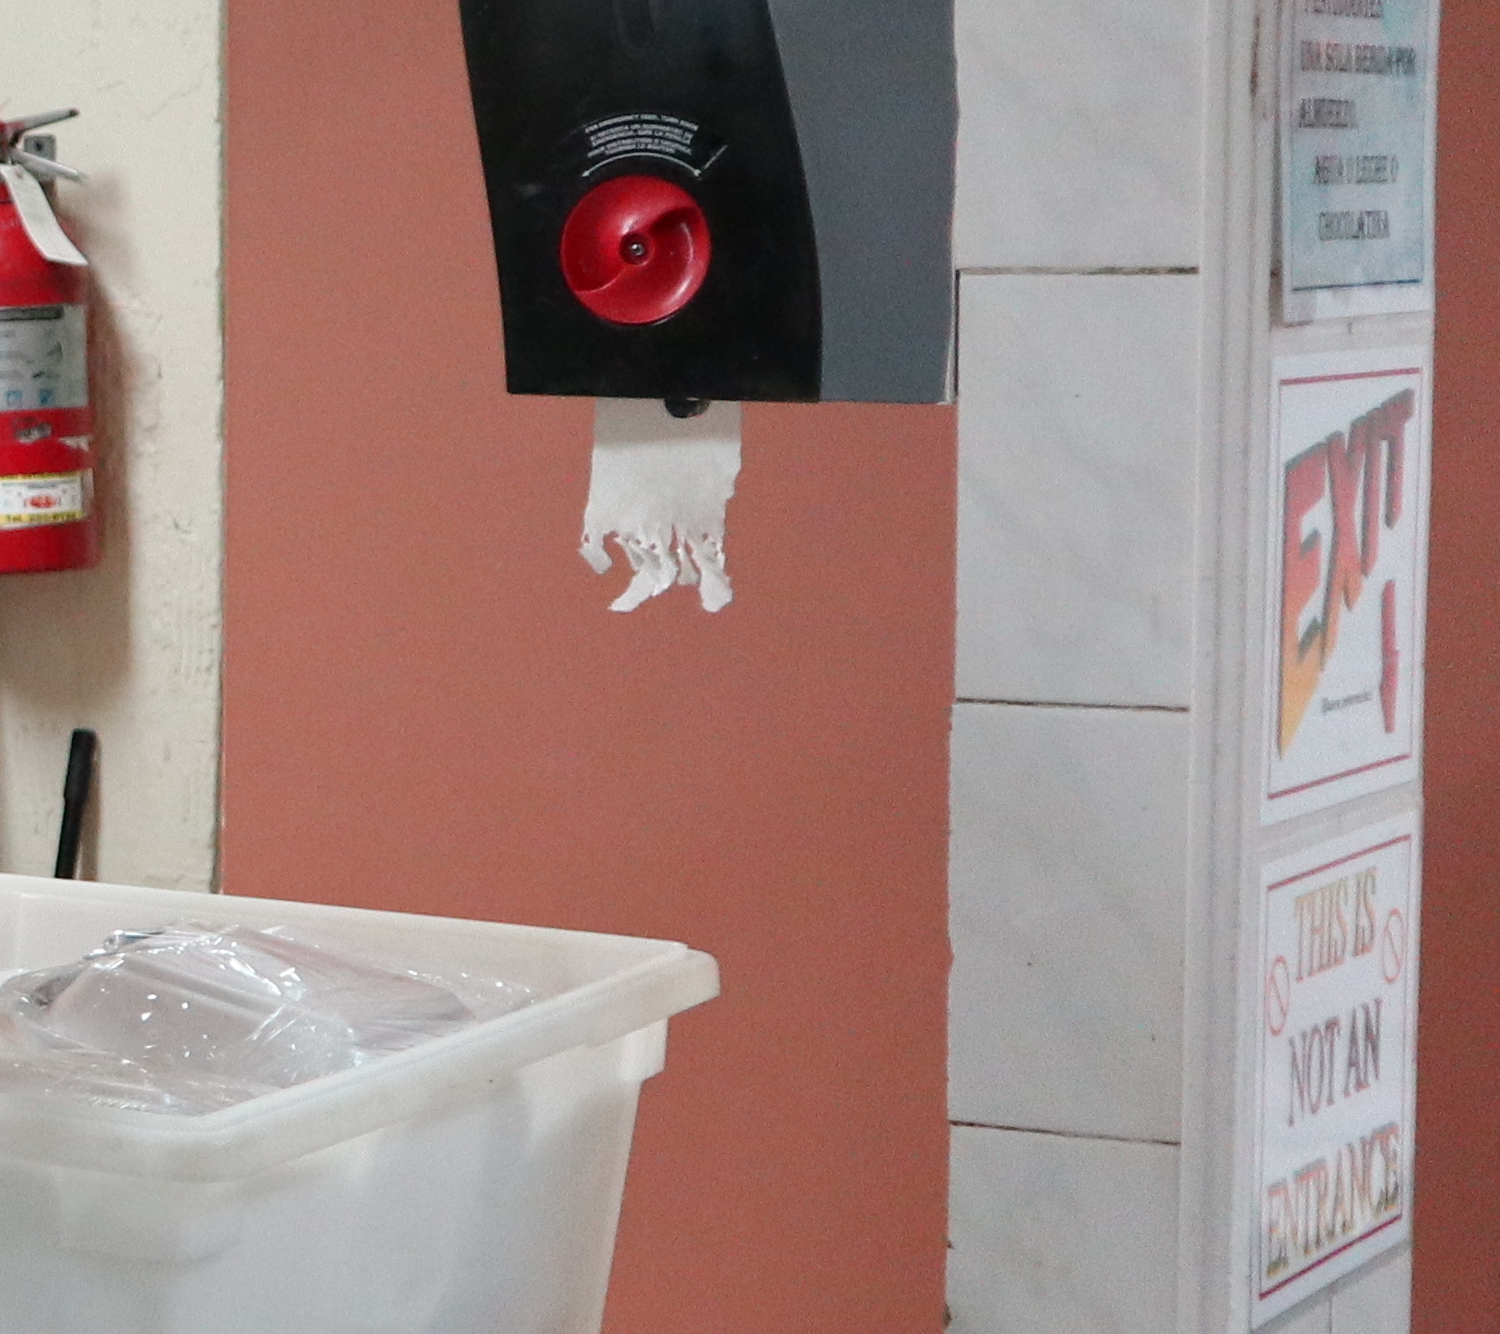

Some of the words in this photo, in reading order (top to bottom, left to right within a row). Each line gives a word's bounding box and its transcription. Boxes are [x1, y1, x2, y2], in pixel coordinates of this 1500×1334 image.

[1280, 387, 1415, 760] EXIT
[1294, 876, 1349, 985] THIS
[1351, 867, 1379, 959] IS
[1287, 1015, 1341, 1128] NOT
[1343, 996, 1383, 1099] AN
[1266, 1120, 1400, 1279] ENTRANCE
